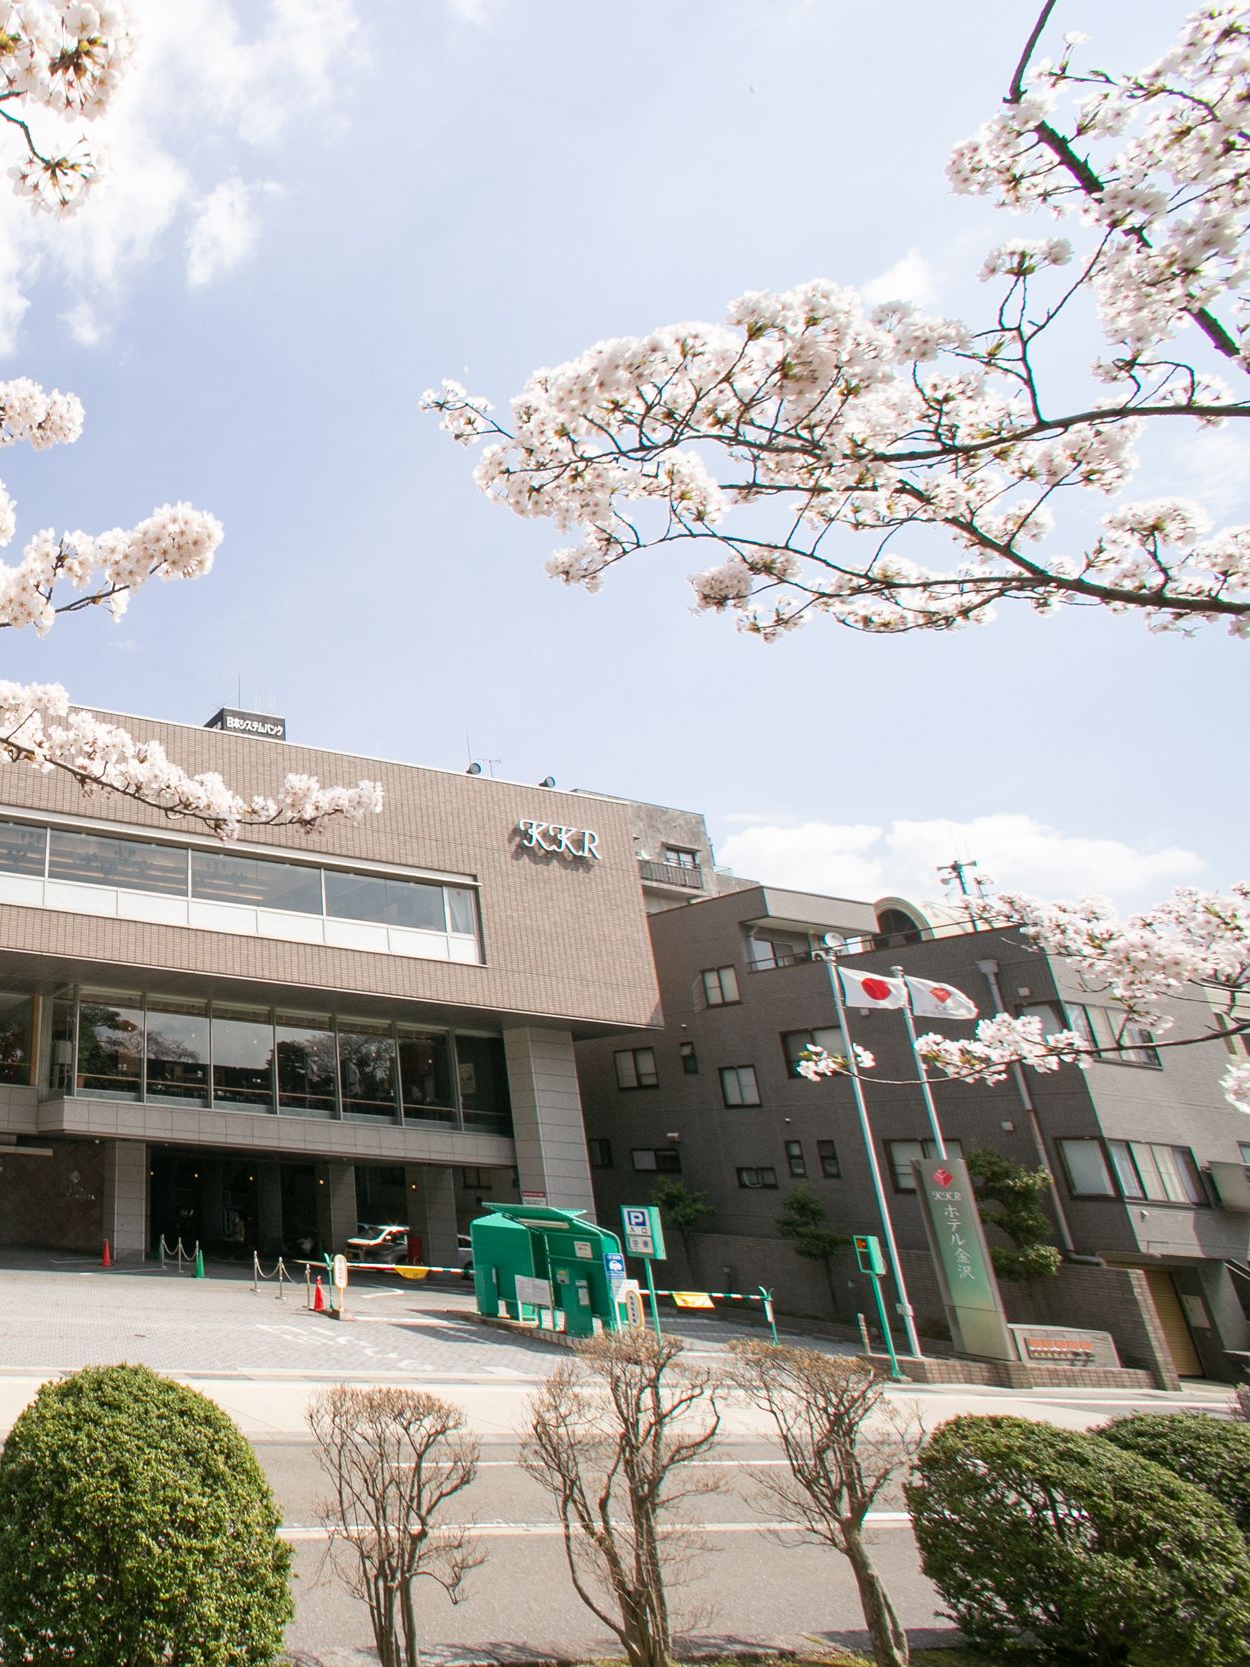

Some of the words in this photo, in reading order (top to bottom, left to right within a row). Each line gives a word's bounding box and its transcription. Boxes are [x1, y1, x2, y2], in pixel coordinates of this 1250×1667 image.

[226, 715, 284, 736] 日本システムバンク
[519, 819, 602, 860] KKR
[932, 1192, 962, 1201] KKR
[630, 1211, 644, 1226] P
[944, 1204, 976, 1280] ホテル金沢
